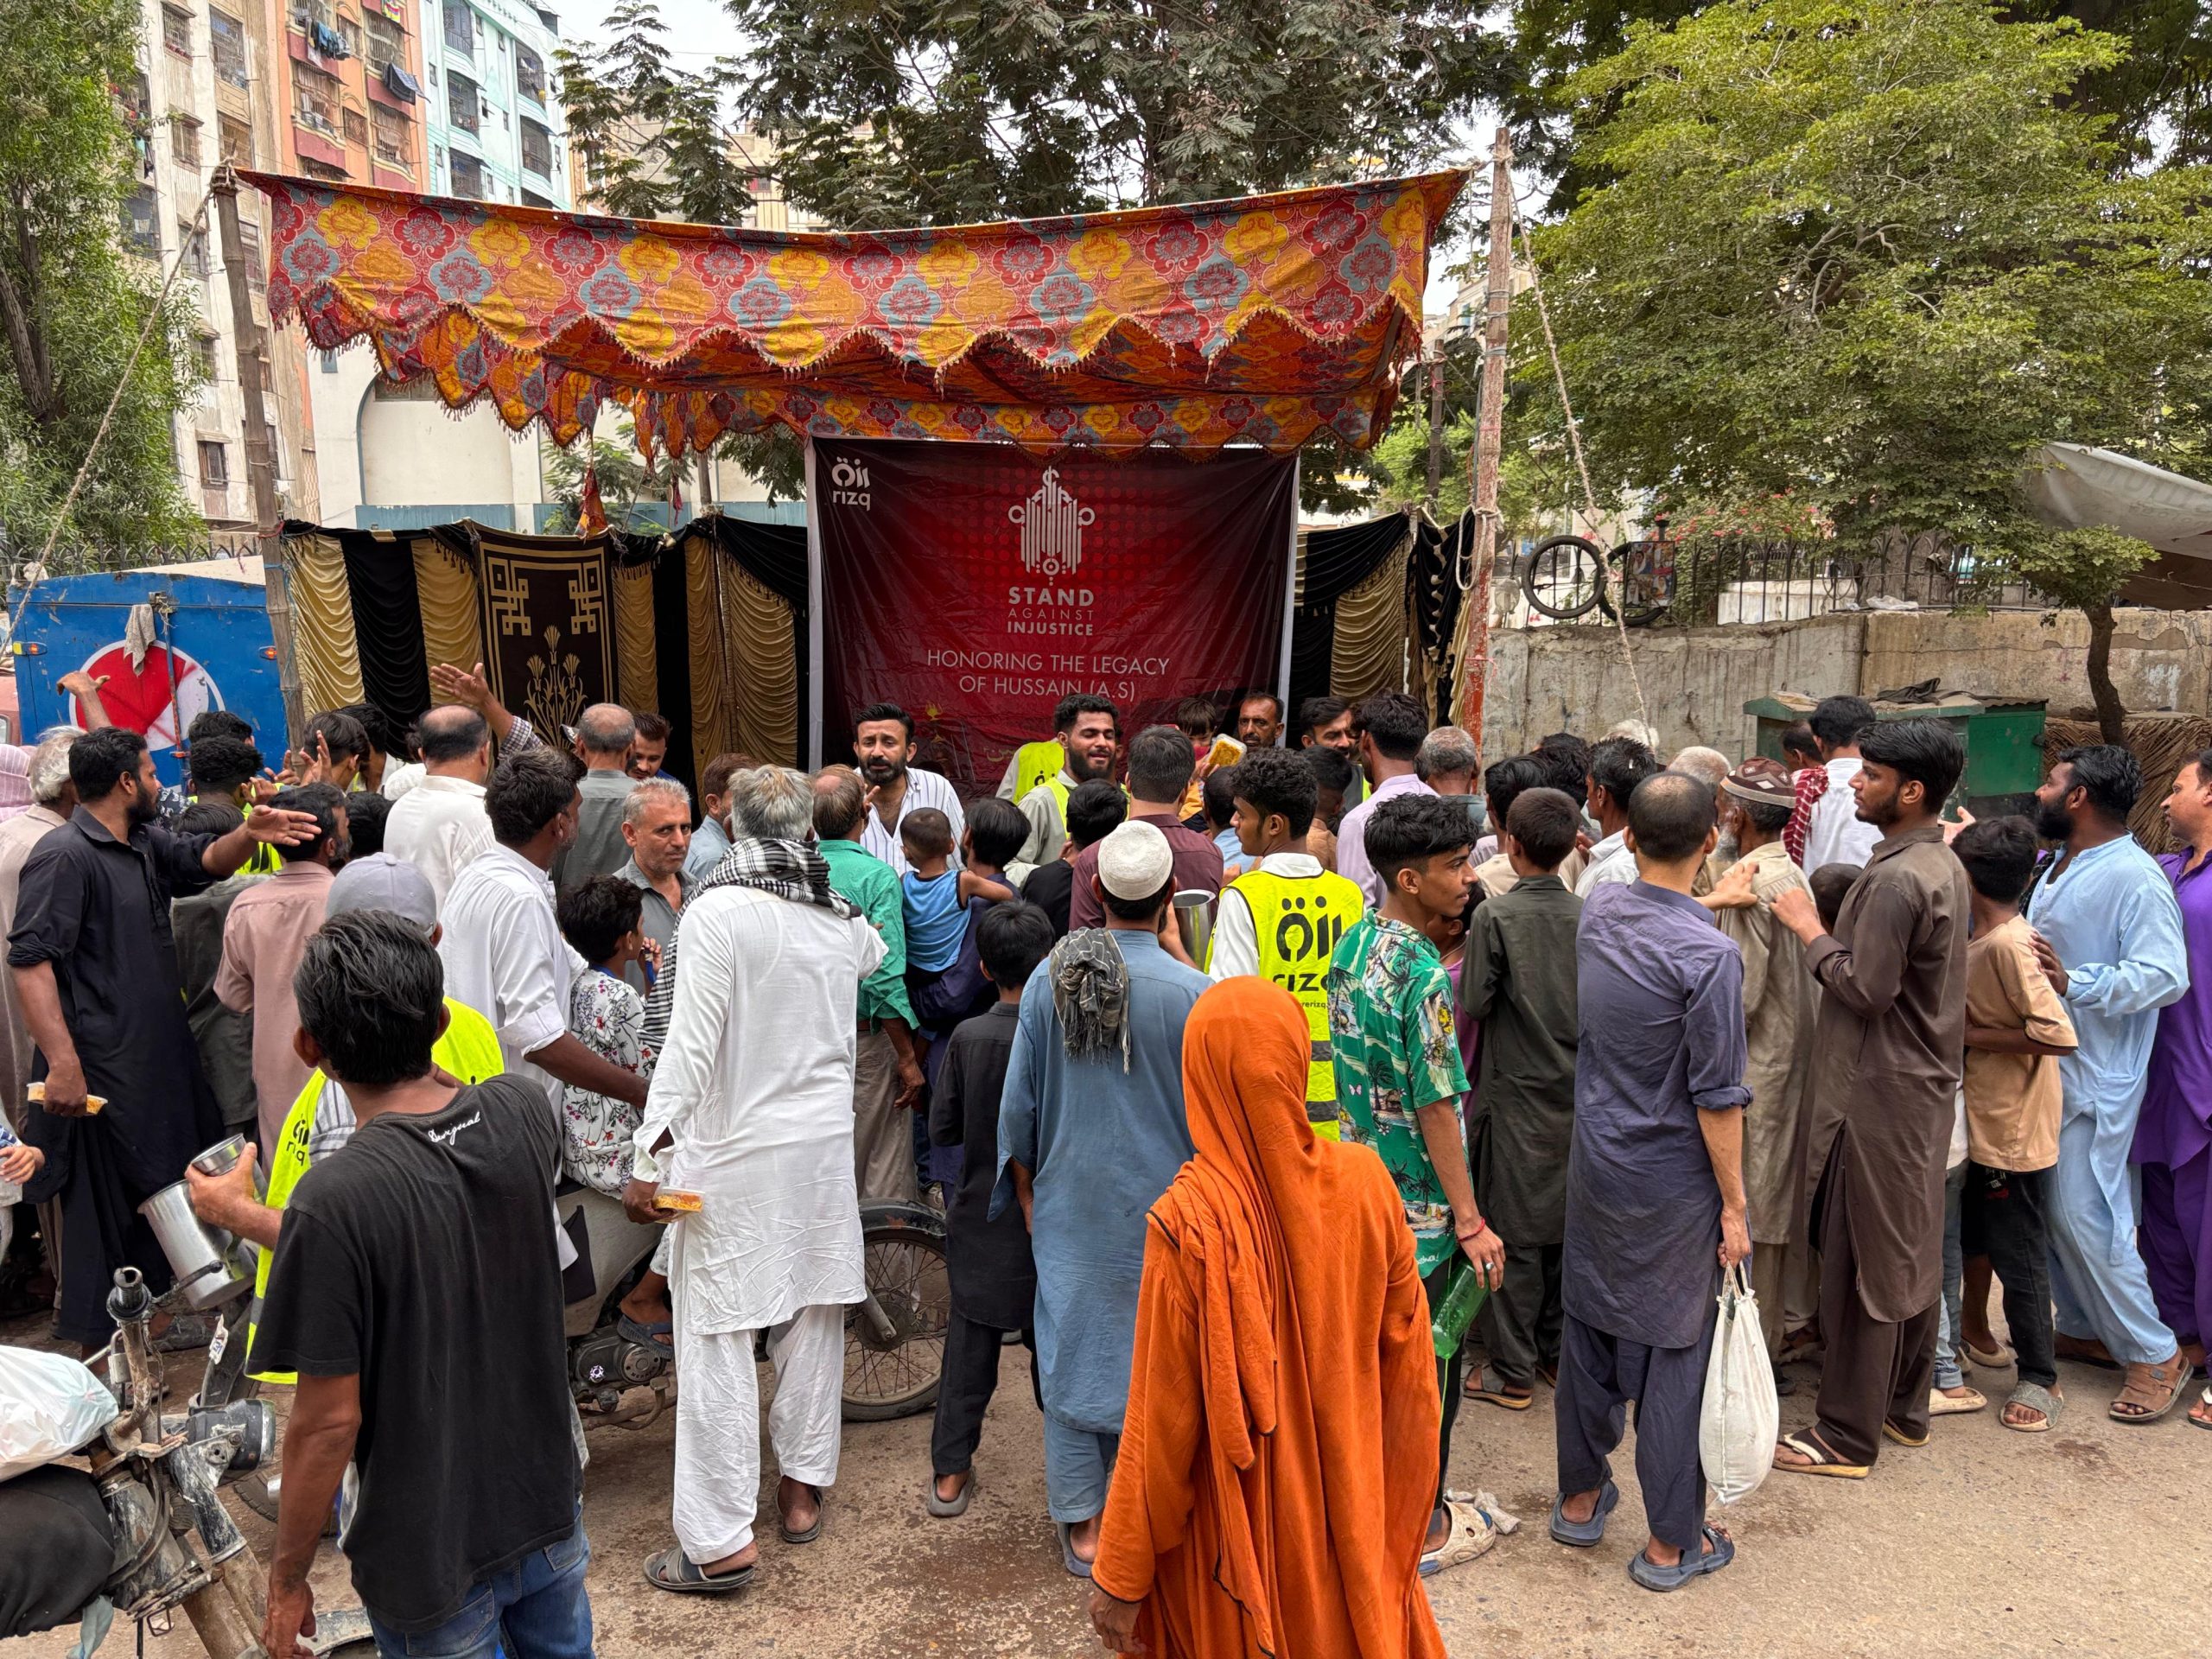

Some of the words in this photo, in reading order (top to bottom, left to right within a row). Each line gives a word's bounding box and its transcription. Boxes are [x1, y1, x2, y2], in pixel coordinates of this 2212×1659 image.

[832, 490, 871, 512] rizq
[1008, 586, 1095, 607] STAND
[1007, 607, 1094, 621] AGAINST
[1007, 621, 1093, 636] INJUSTICE
[927, 649, 1043, 671] HONORING
[1050, 654, 1085, 673] THE
[1092, 656, 1170, 676] LEGACY
[959, 675, 987, 693] OF
[994, 677, 1082, 696] HUSSAIN
[1090, 679, 1135, 702] (A.S)
